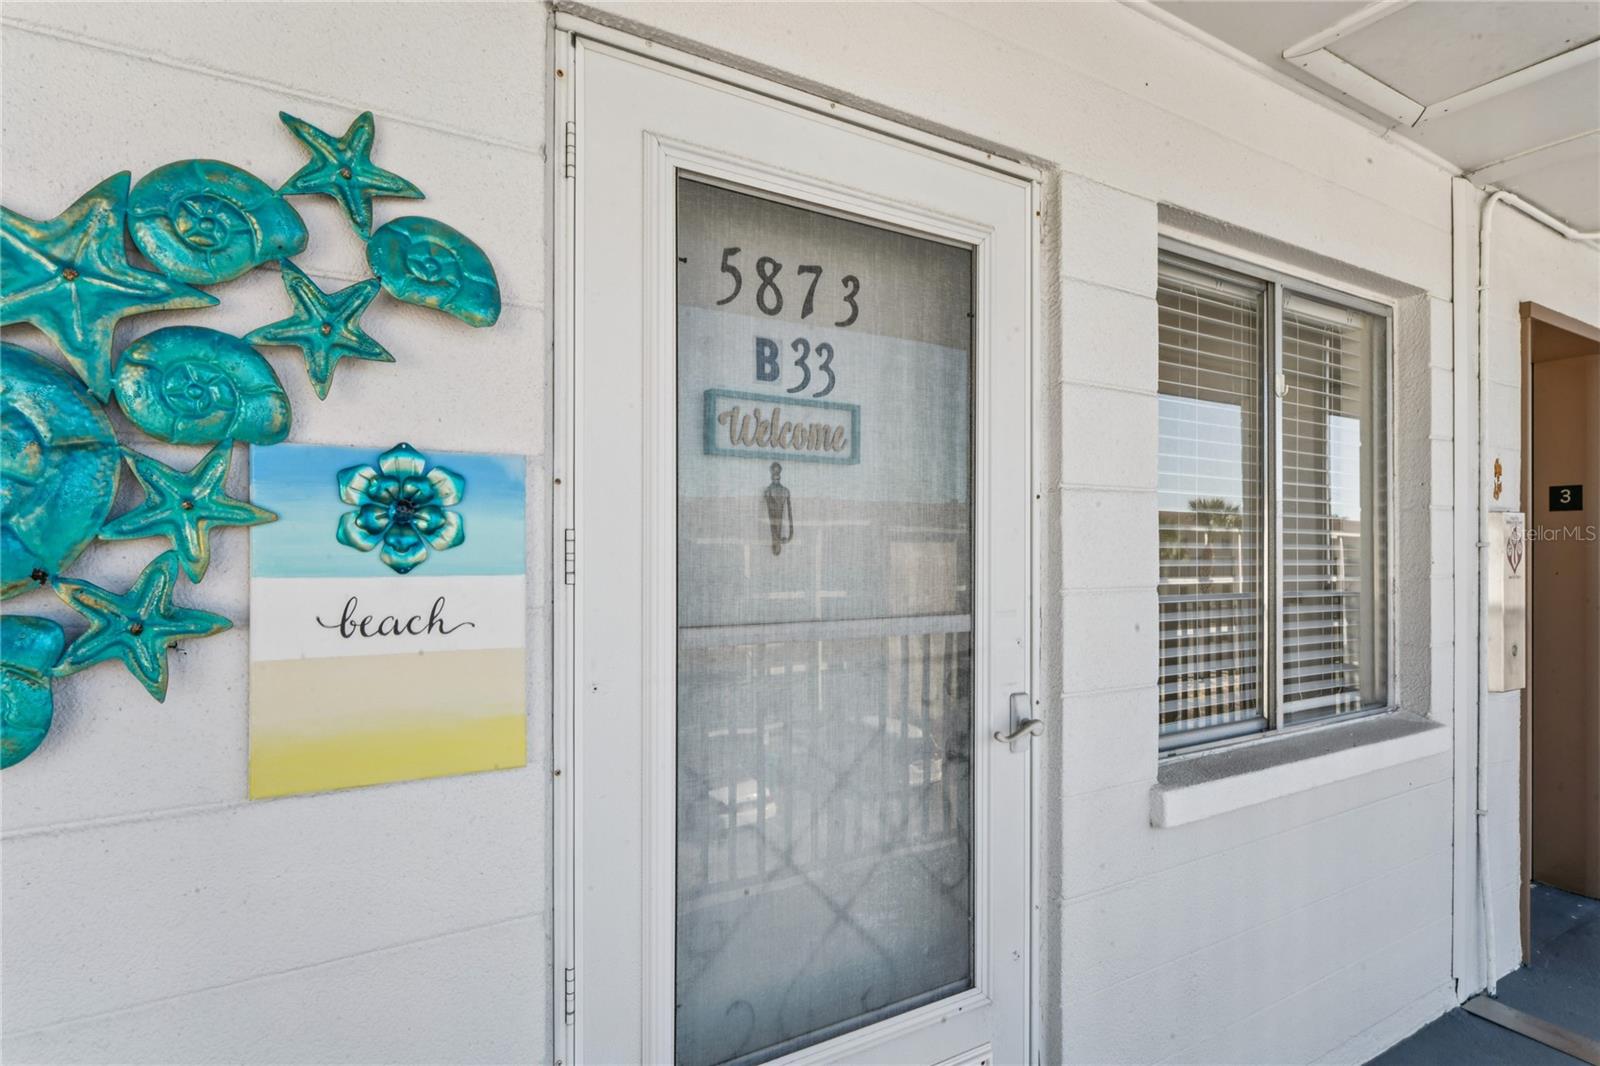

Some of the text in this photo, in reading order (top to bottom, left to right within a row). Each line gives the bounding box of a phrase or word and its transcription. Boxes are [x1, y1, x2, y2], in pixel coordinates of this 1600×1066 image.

[716, 246, 861, 328] 5873
[717, 405, 848, 453] Welcome
[1560, 489, 1571, 504] 3
[316, 596, 476, 638] beach
